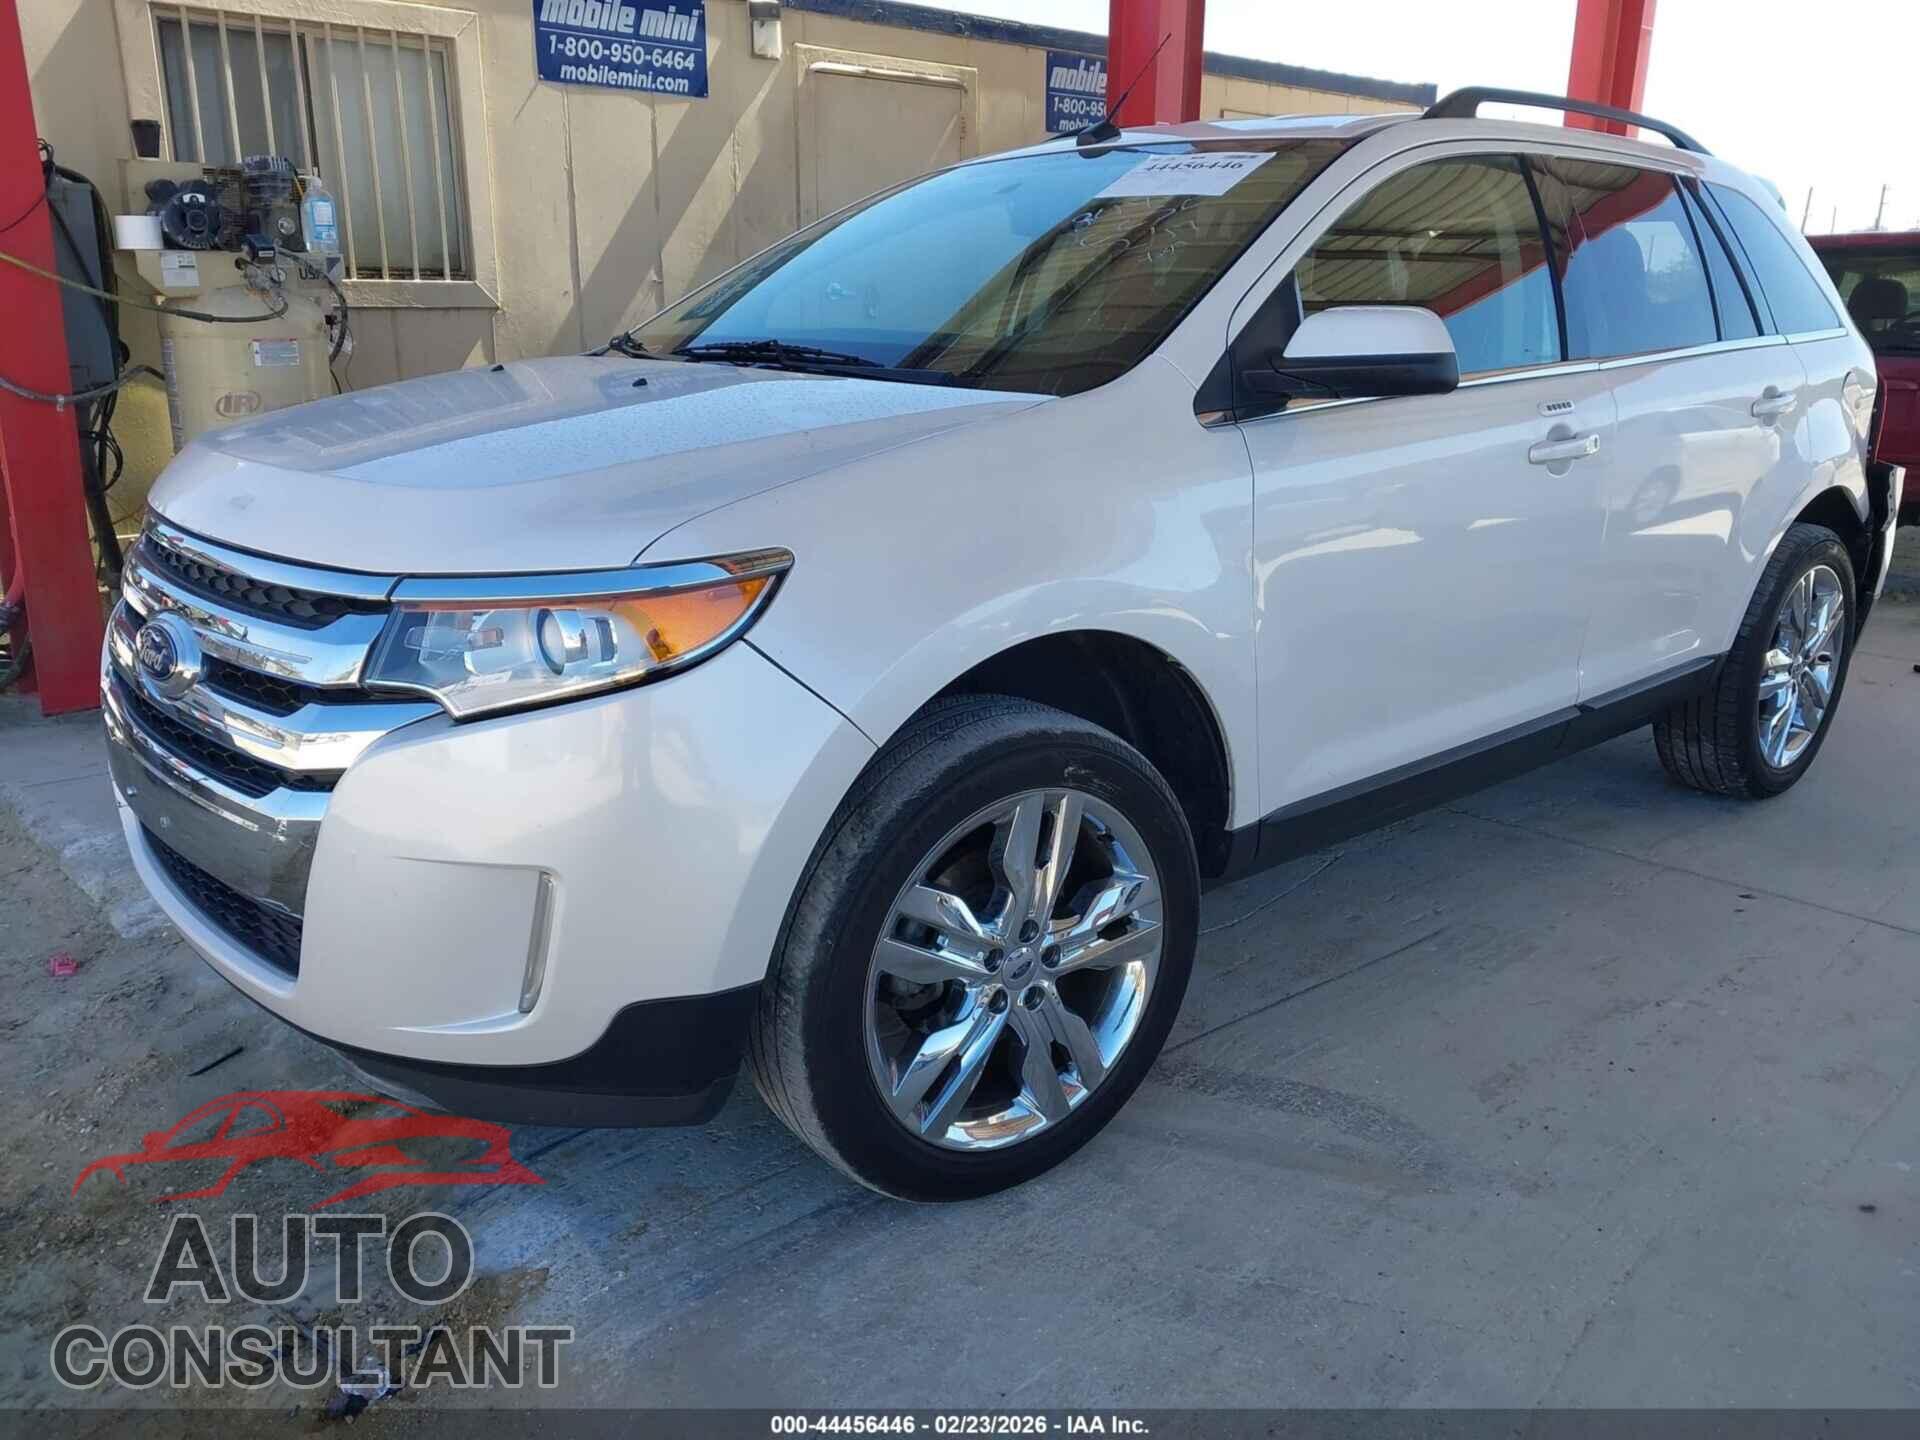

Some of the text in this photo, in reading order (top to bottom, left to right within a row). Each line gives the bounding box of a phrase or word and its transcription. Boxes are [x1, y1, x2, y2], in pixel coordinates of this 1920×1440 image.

[540, 0, 700, 42] mobile mini
[549, 35, 695, 71] 1-800-950-6464
[560, 64, 689, 93] mobilemini.com
[1049, 59, 1108, 94] mobile
[1053, 96, 1107, 117] 1-800-95
[140, 629, 169, 671] Ford
